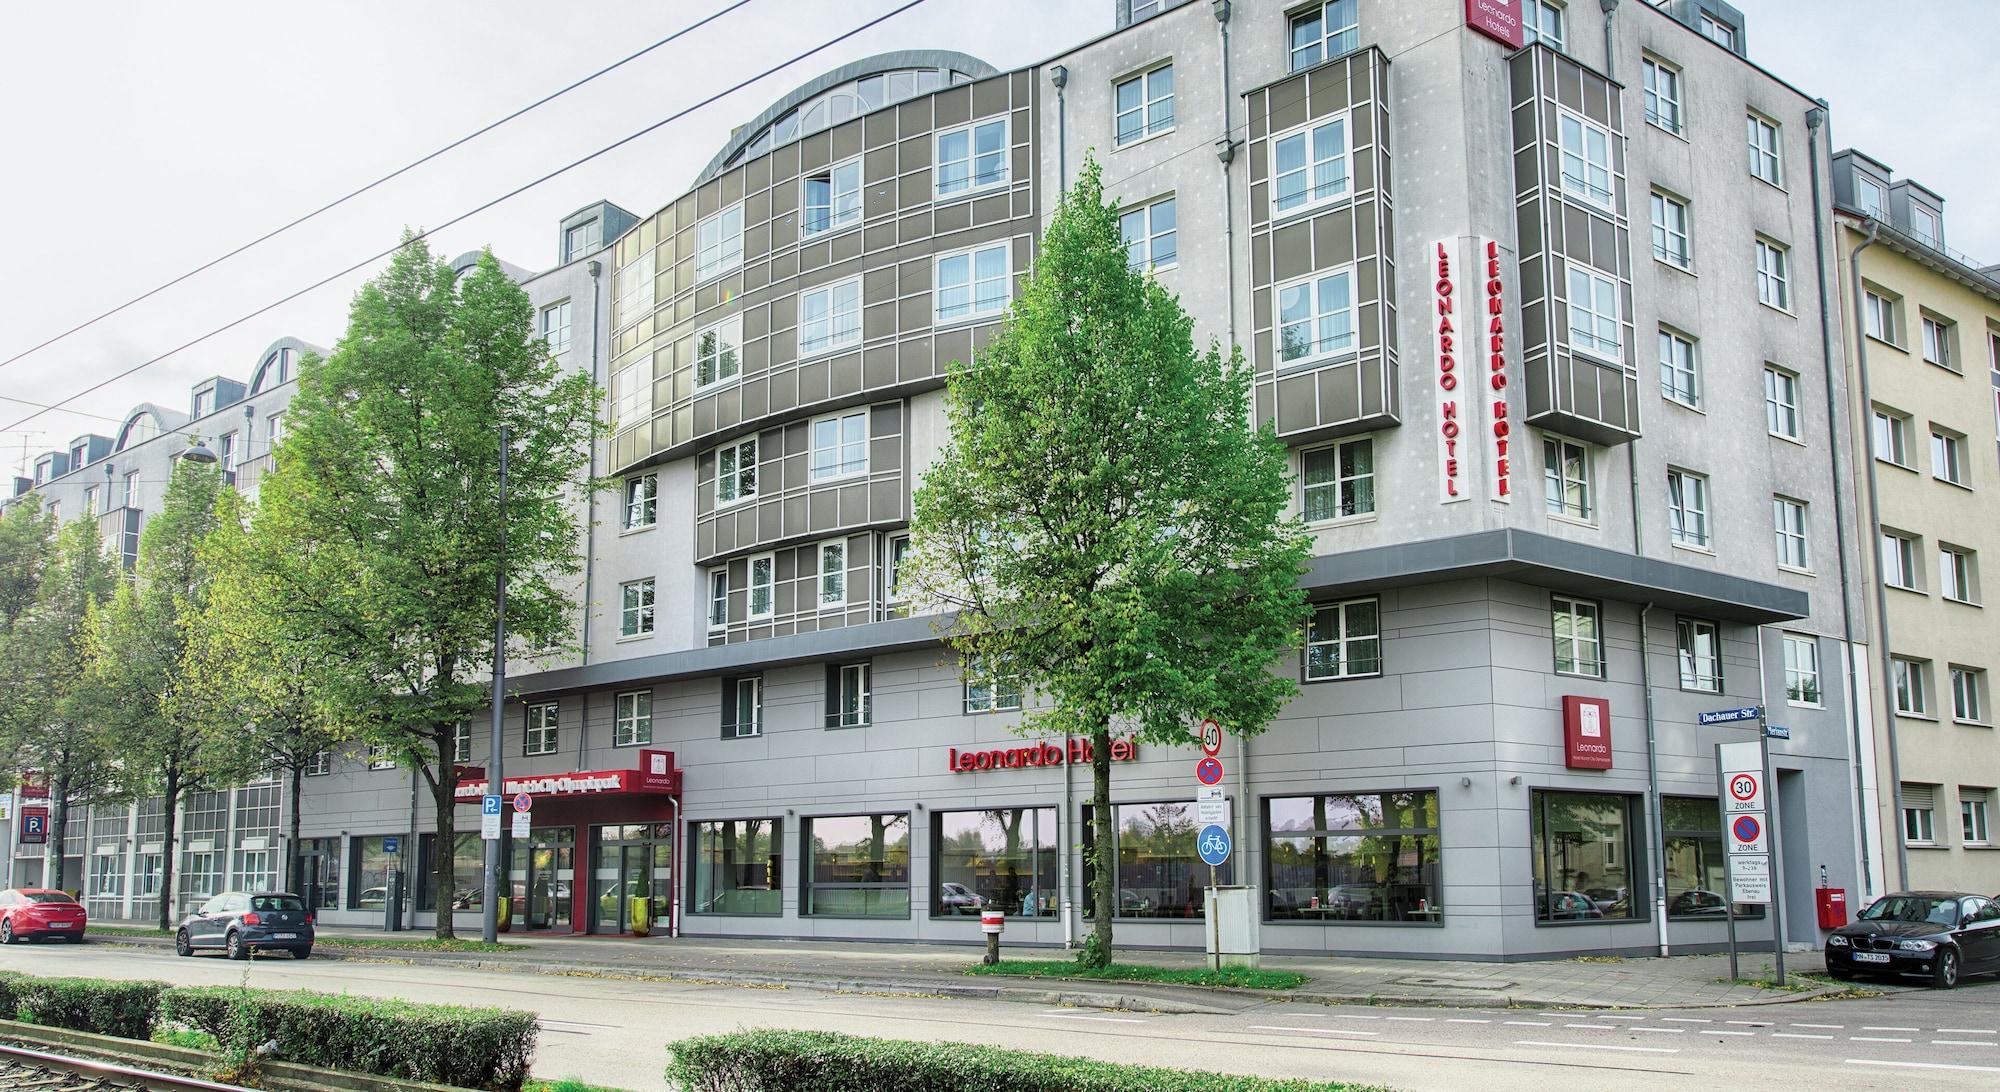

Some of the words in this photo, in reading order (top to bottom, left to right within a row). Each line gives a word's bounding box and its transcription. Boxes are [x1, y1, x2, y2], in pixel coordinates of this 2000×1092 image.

[1478, 0, 1516, 26] Leonardo
[1486, 16, 1510, 37] Hotels
[1436, 242, 1457, 391] LEONARDO
[1487, 241, 1508, 391] LEONARDO
[1442, 401, 1459, 496] HOTEL
[1493, 401, 1511, 497] HOTEL
[1702, 711, 1739, 723] Dachauer
[1741, 708, 1755, 718] Str.
[1205, 728, 1217, 746] 60
[949, 740, 1063, 772] Leonardo
[1576, 741, 1607, 753] Leonardo
[646, 776, 670, 785] Leonardo
[1735, 781, 1752, 794] 30
[1735, 802, 1756, 810] ZONE
[1737, 844, 1758, 852] ZONE
